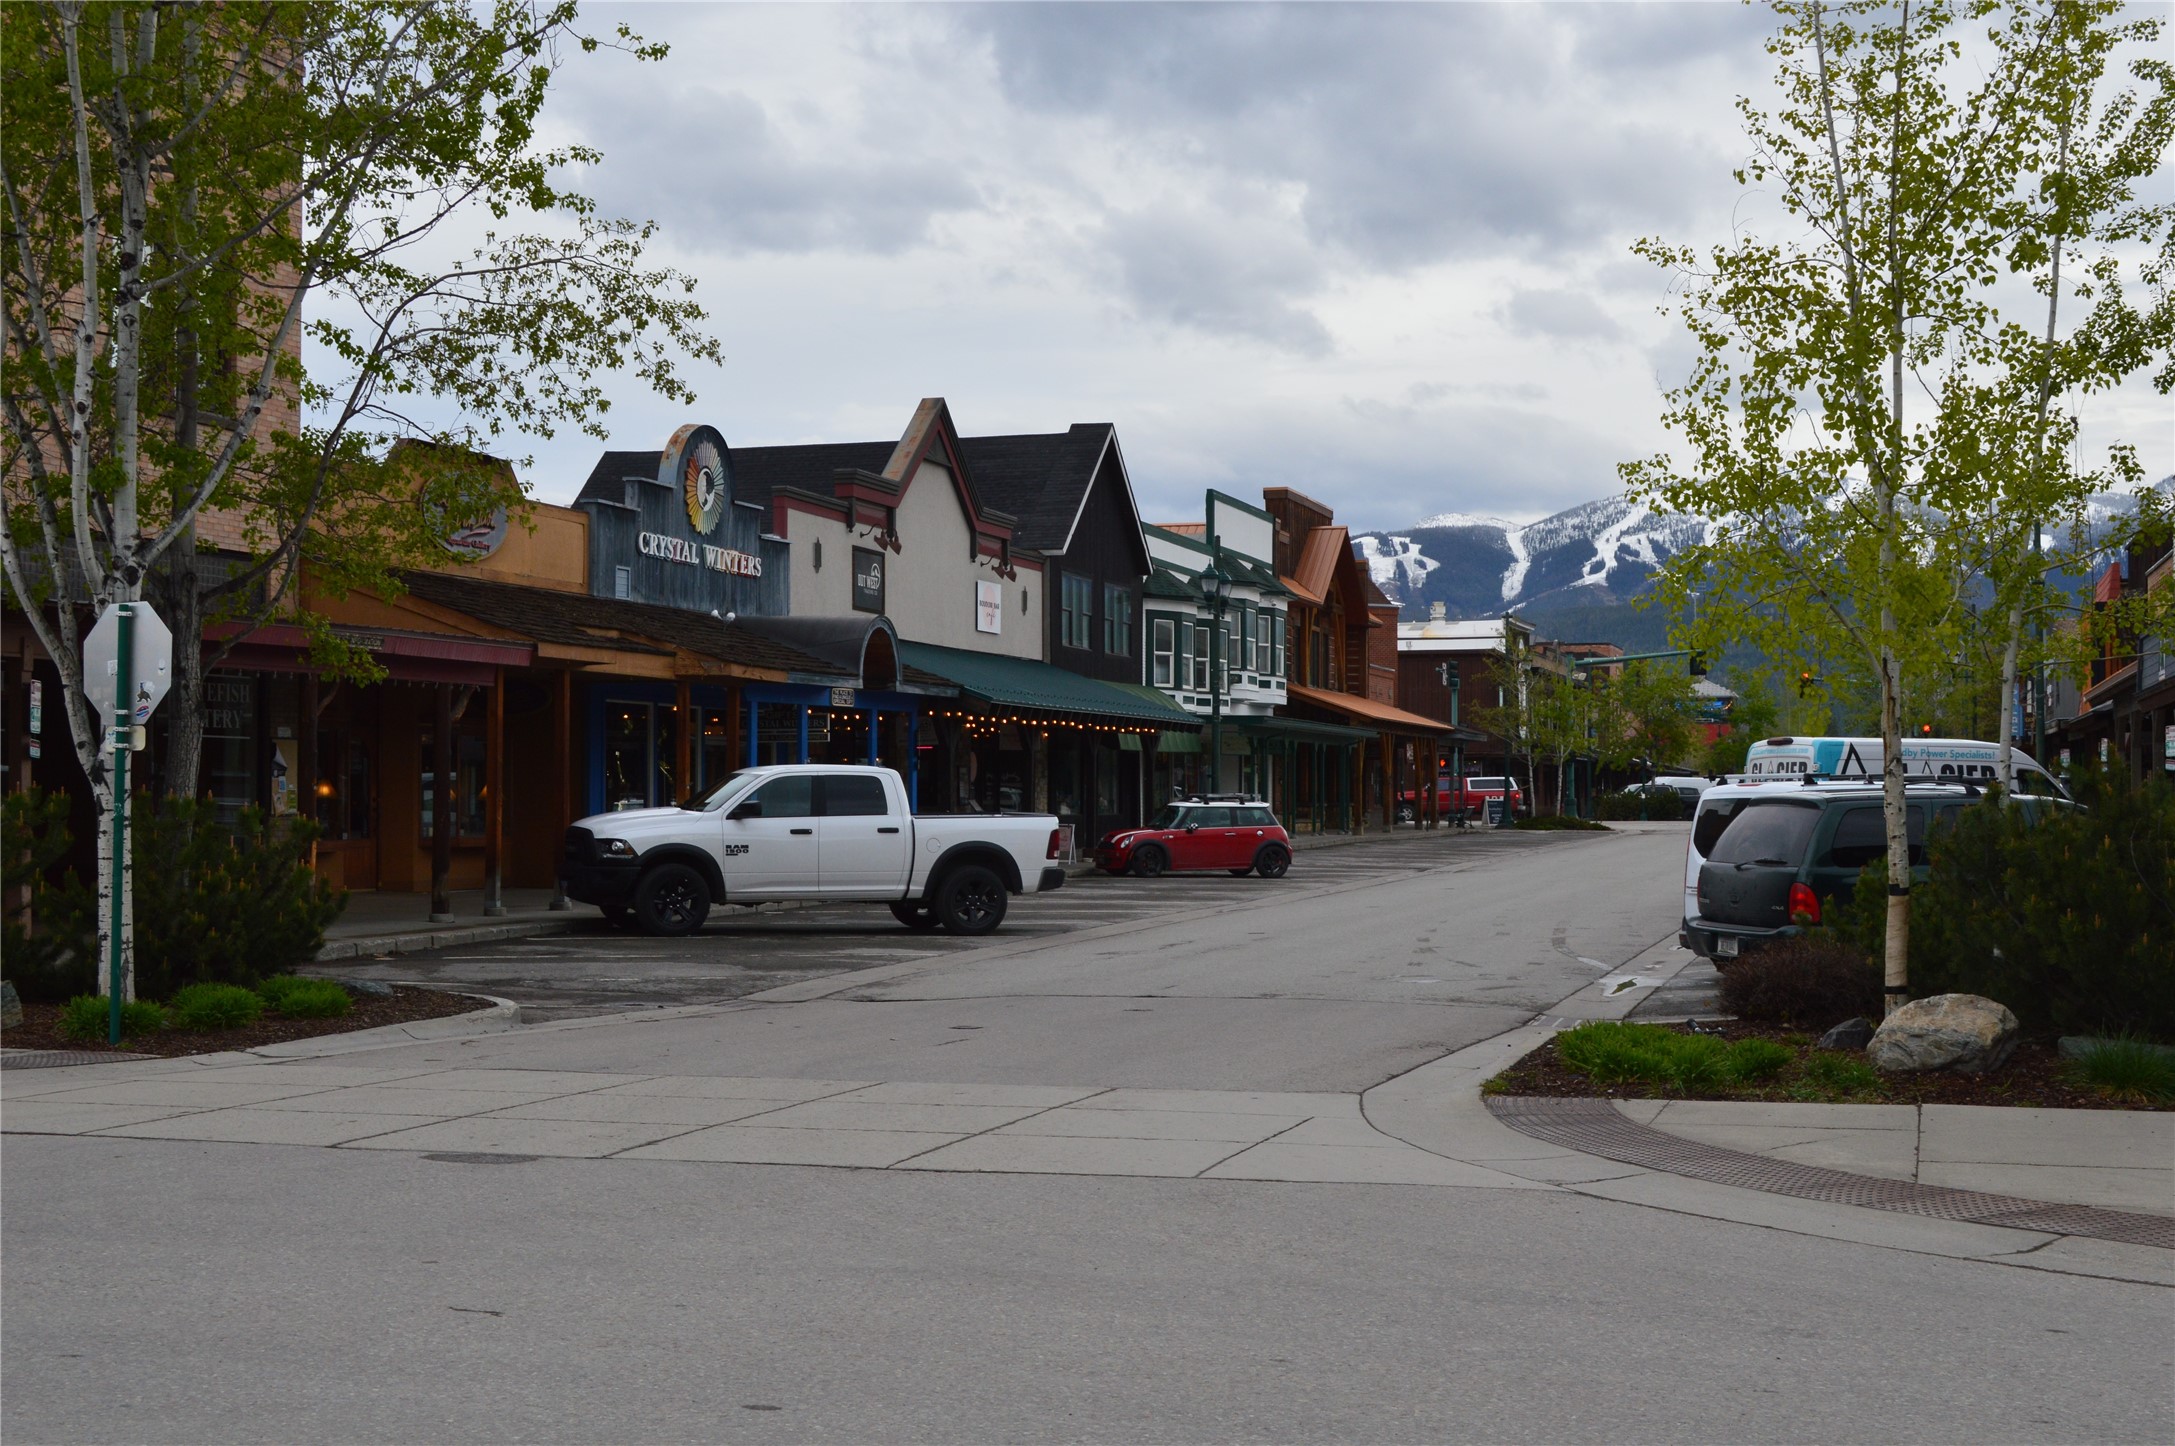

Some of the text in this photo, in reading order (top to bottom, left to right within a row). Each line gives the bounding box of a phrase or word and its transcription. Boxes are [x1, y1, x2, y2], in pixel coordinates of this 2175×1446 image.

[638, 531, 762, 577] CRYSTAL WINTERS
[857, 573, 878, 590] OUT WEST
[206, 683, 250, 703] EFISH
[203, 708, 241, 728] TERY
[1902, 747, 1996, 761] dby Power Specialists!
